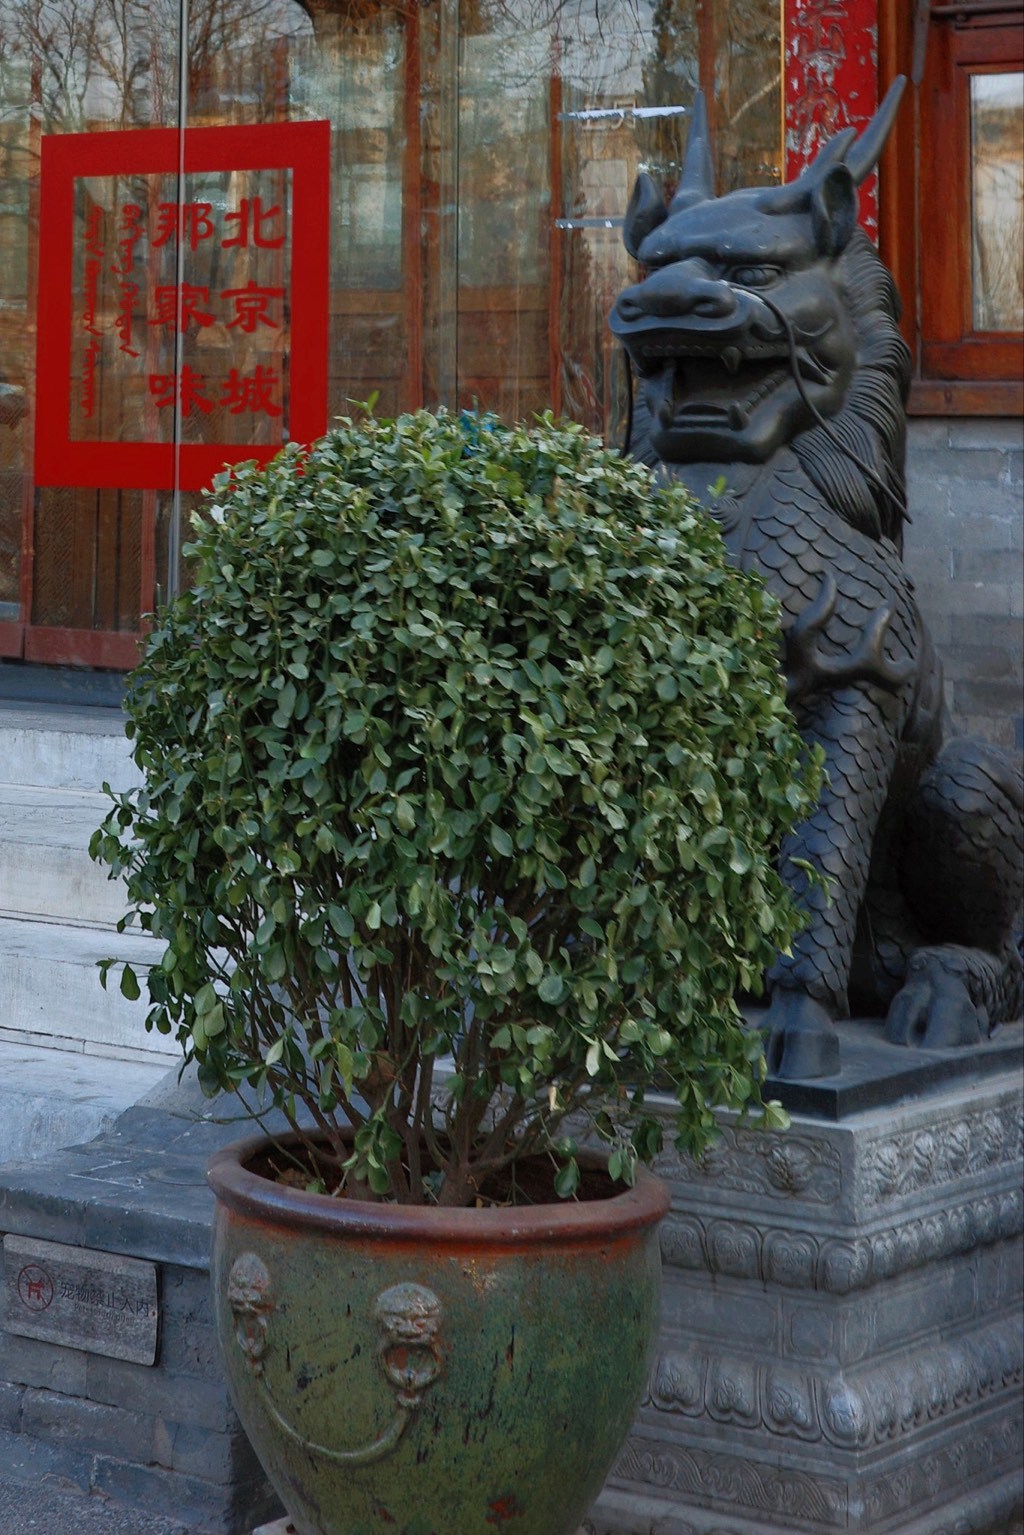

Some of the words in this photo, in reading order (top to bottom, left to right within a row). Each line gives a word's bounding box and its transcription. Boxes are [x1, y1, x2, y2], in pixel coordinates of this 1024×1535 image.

[147, 201, 216, 418] 那家味
[219, 197, 286, 418] 北京城
[59, 1281, 150, 1318] 宠物禁止入内
